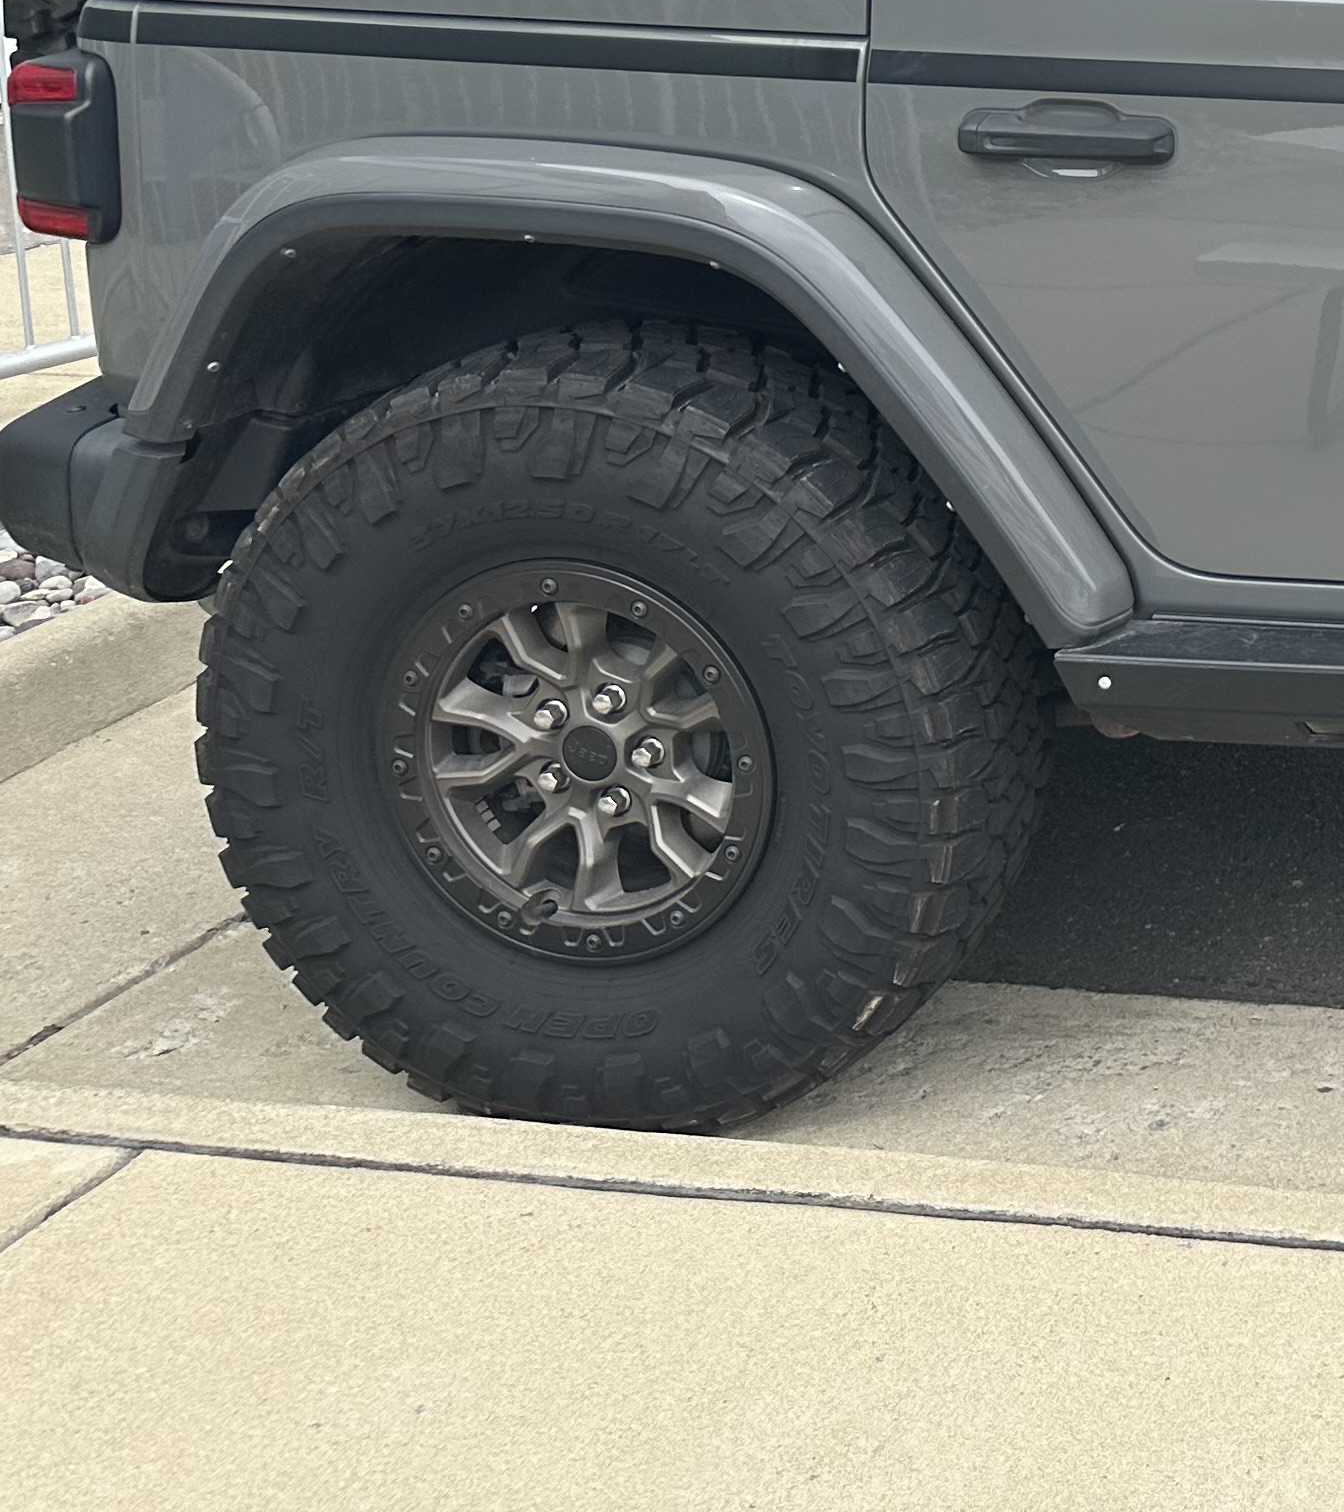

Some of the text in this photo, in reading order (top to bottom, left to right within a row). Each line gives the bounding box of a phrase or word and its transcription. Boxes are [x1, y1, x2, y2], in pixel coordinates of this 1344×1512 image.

[311, 825, 501, 1018] COUNTRY
[754, 802, 832, 977] TIRES
[502, 1005, 661, 1039] OPEN
